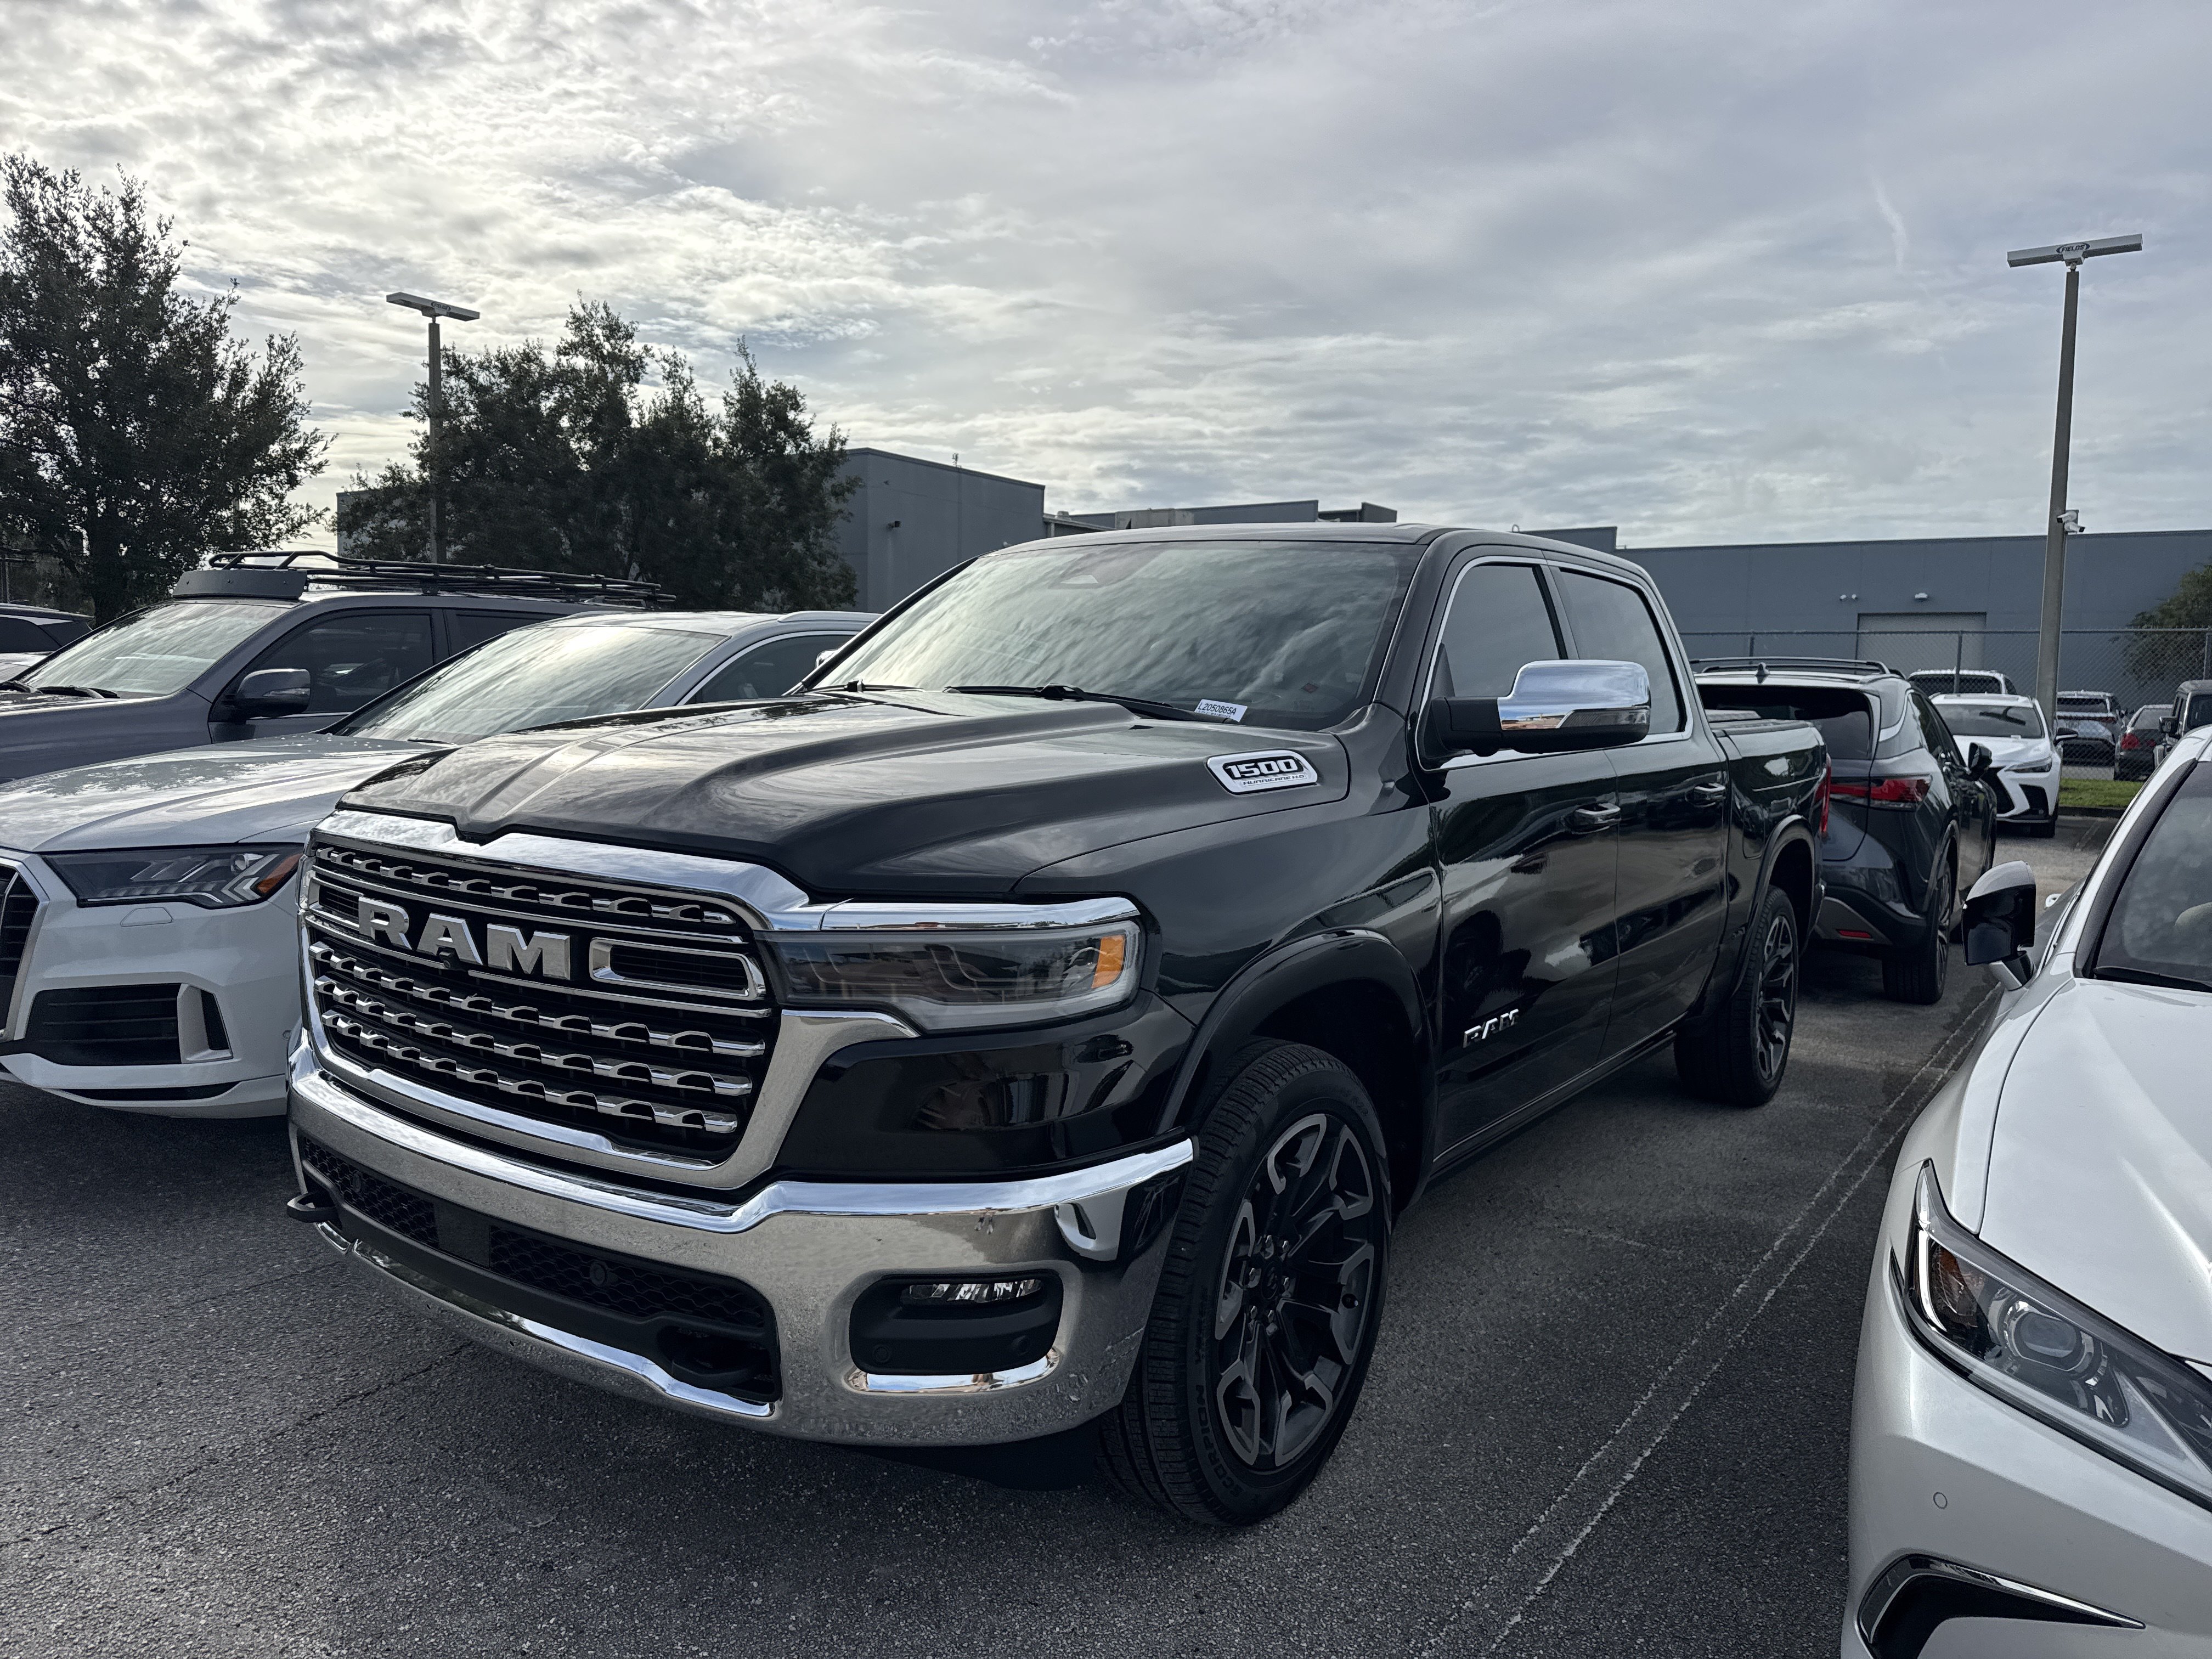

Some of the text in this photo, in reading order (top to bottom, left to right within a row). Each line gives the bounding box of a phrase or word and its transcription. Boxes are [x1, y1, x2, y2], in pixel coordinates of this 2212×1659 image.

[2061, 245, 2085, 253] FIELDS
[1198, 702, 1237, 715] L2050865A
[1225, 759, 1298, 778] 1500
[1243, 776, 1291, 785] HURRICANE
[358, 896, 571, 980] RAM
